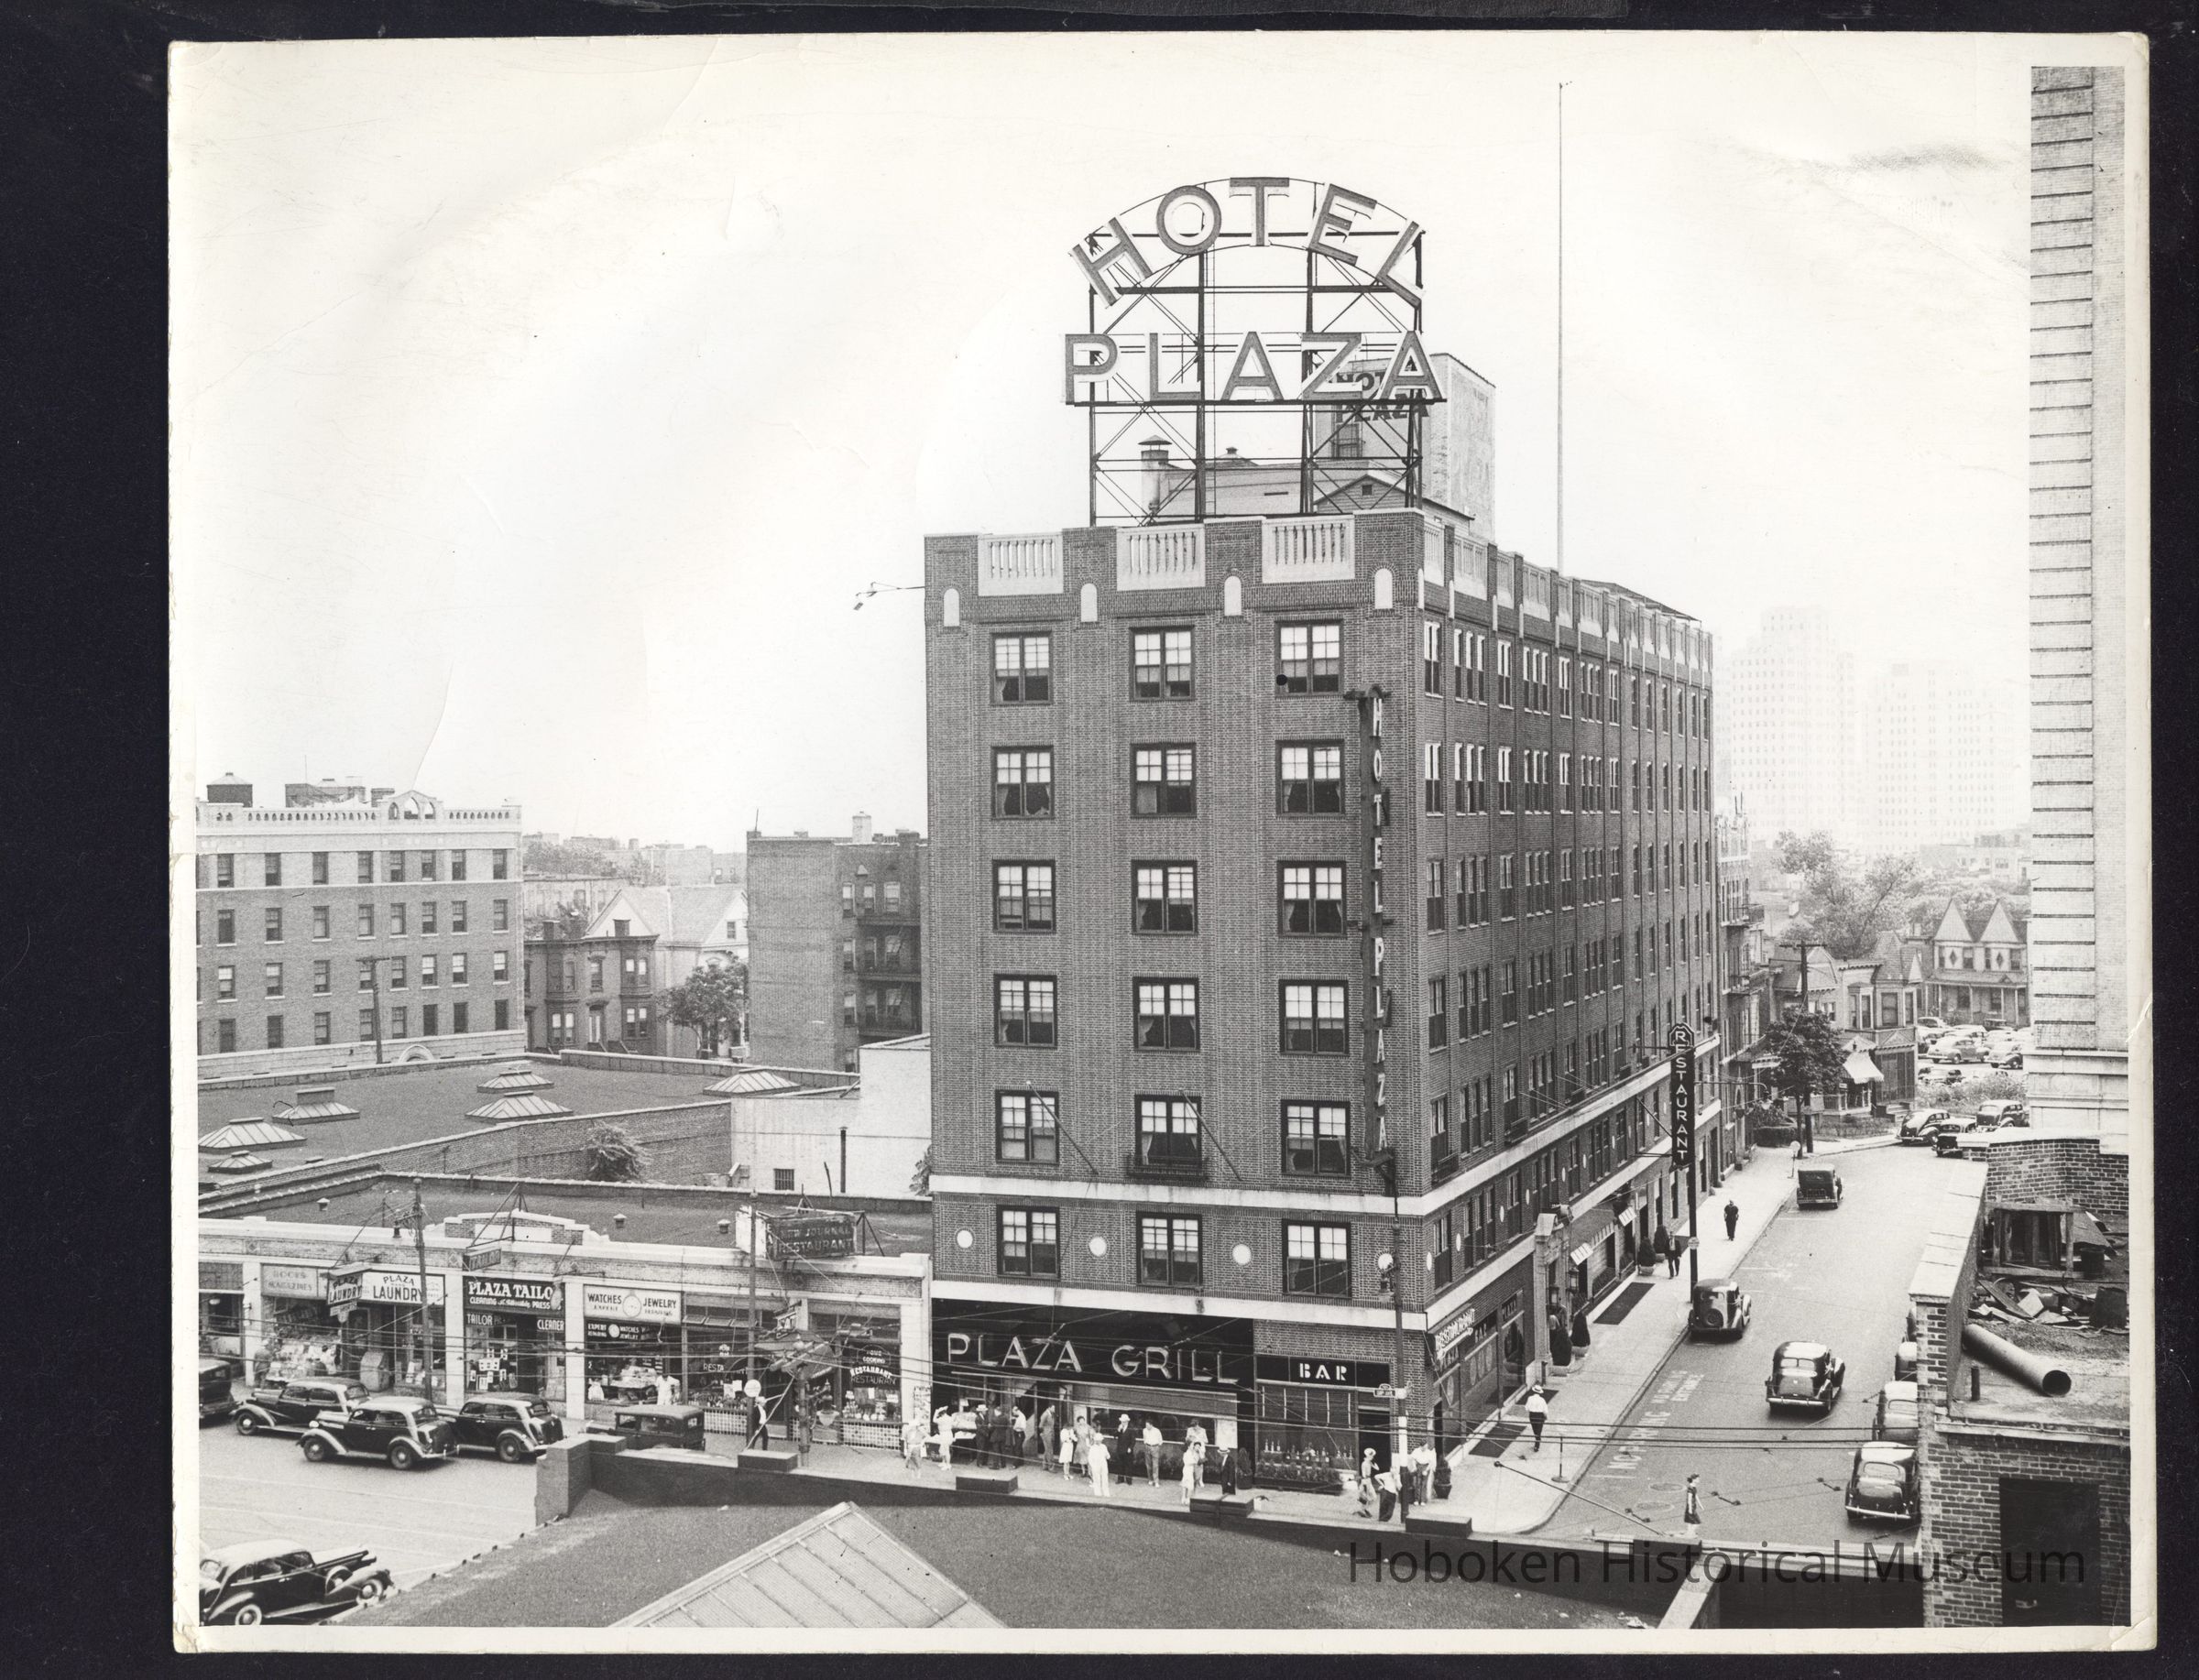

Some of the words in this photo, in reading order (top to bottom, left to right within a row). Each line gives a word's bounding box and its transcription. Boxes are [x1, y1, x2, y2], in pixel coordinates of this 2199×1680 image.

[1069, 177, 1426, 309] HOTEL
[1063, 331, 1444, 401] PLAZA
[1373, 698, 1383, 913] HOTEL
[1373, 937, 1388, 1151] PLAZA
[1675, 1030, 1689, 1161] RESTAURANT
[382, 1274, 415, 1286] PLAZA
[329, 1284, 363, 1304] LAUNDRY
[468, 1281, 512, 1298] PLAZA
[512, 1284, 554, 1300] TAILO
[587, 1293, 622, 1305] WATCHES
[642, 1297, 677, 1310] JEWELRY
[466, 1313, 494, 1326] TAILOR
[536, 1319, 564, 1332] CLEANER
[587, 1323, 607, 1332] EXPERT
[947, 1333, 1083, 1373] PLAZA
[1110, 1344, 1240, 1385] GRILL
[1299, 1362, 1348, 1381] BAR
